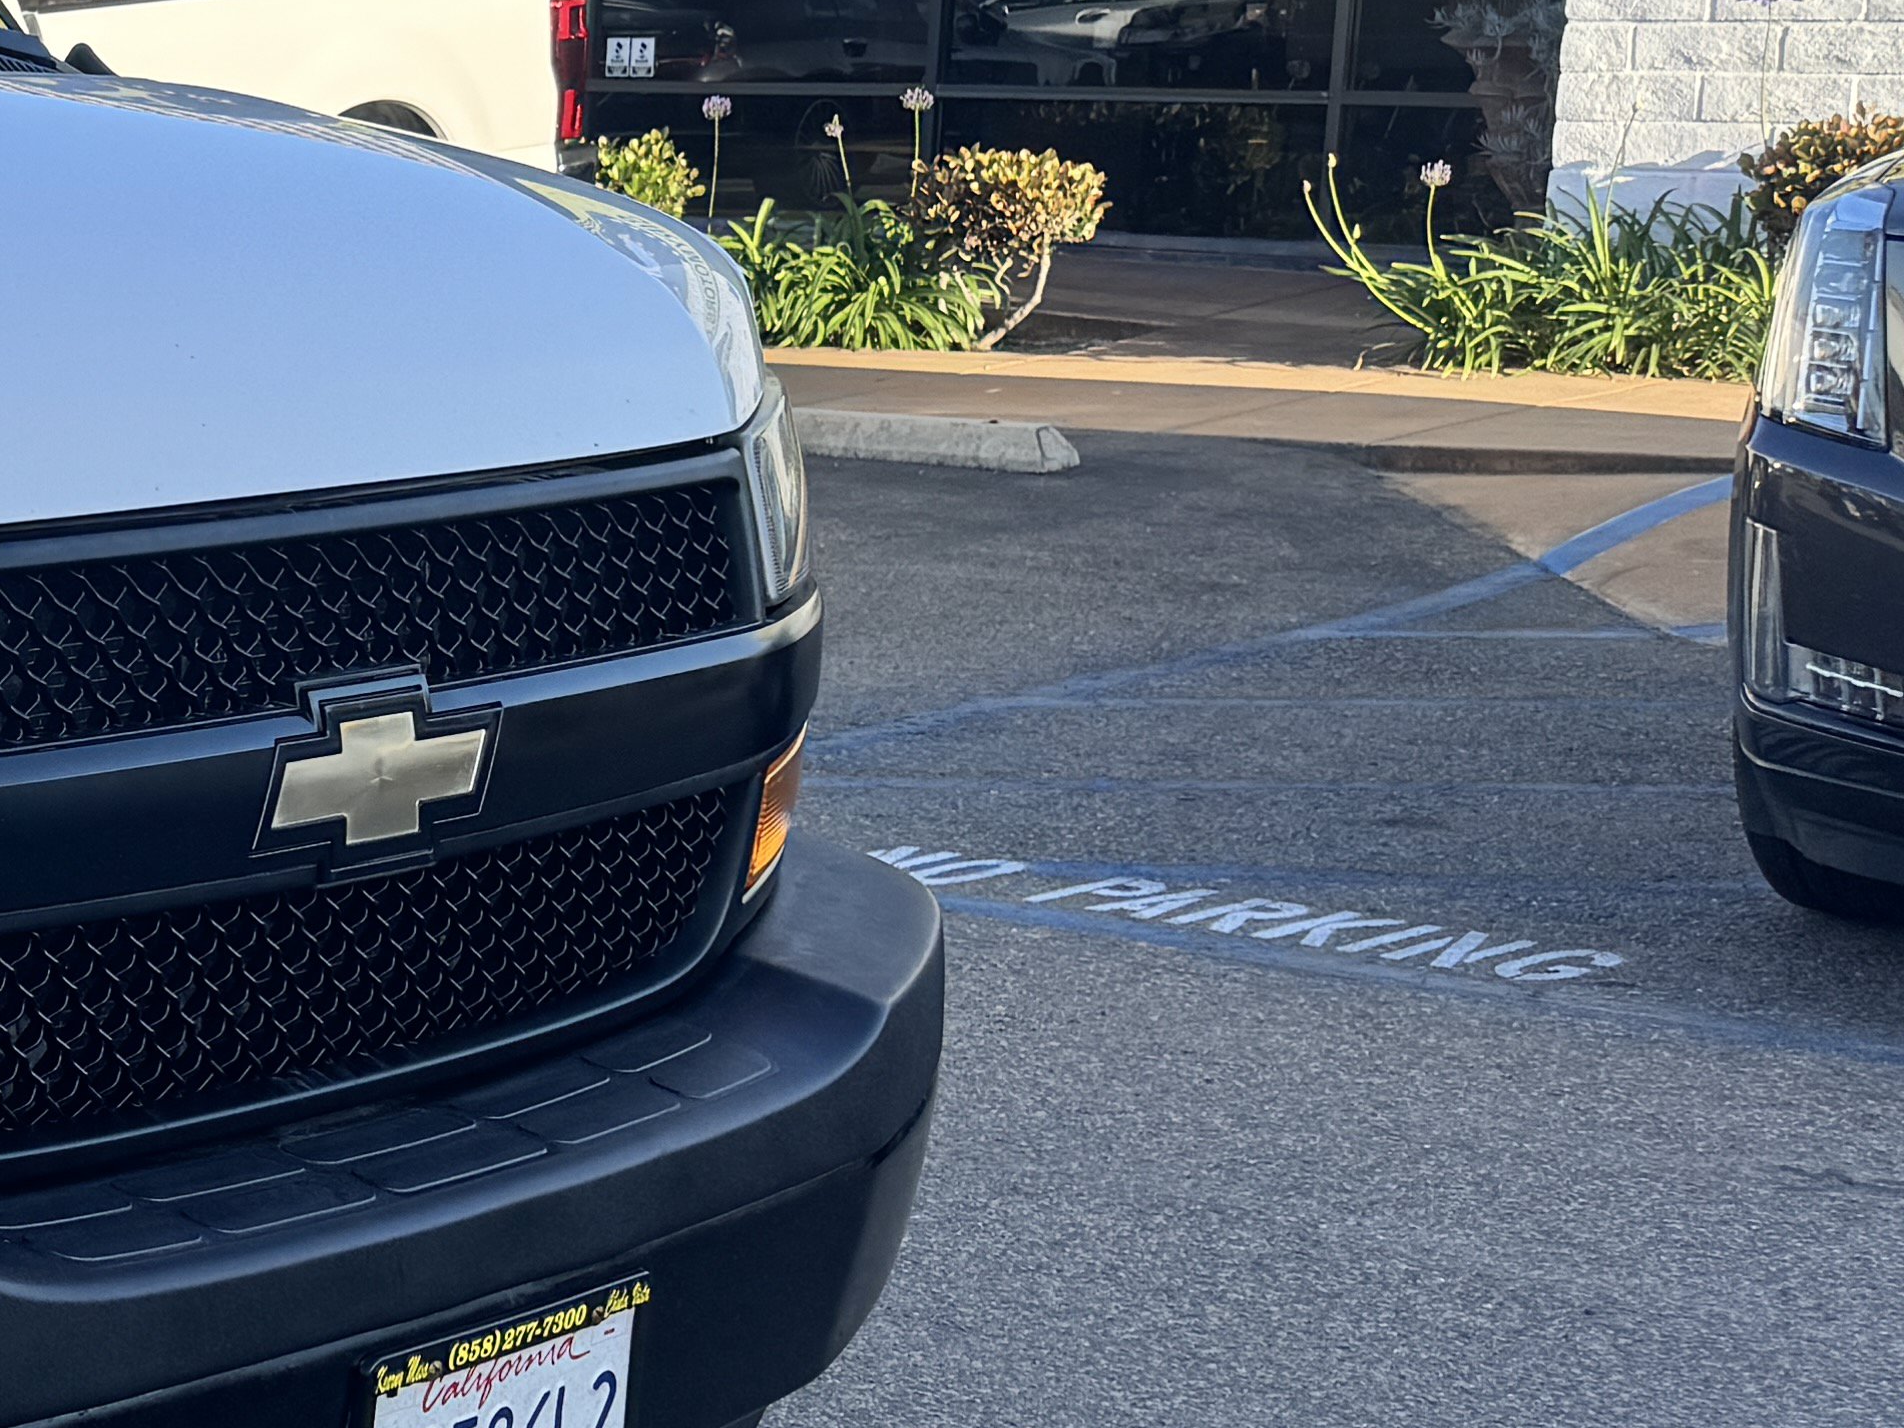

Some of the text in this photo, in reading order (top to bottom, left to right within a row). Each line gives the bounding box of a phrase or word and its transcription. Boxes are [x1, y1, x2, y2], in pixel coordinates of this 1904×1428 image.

[867, 845, 1624, 982] NO PARKING
[422, 1333, 590, 1413] California
